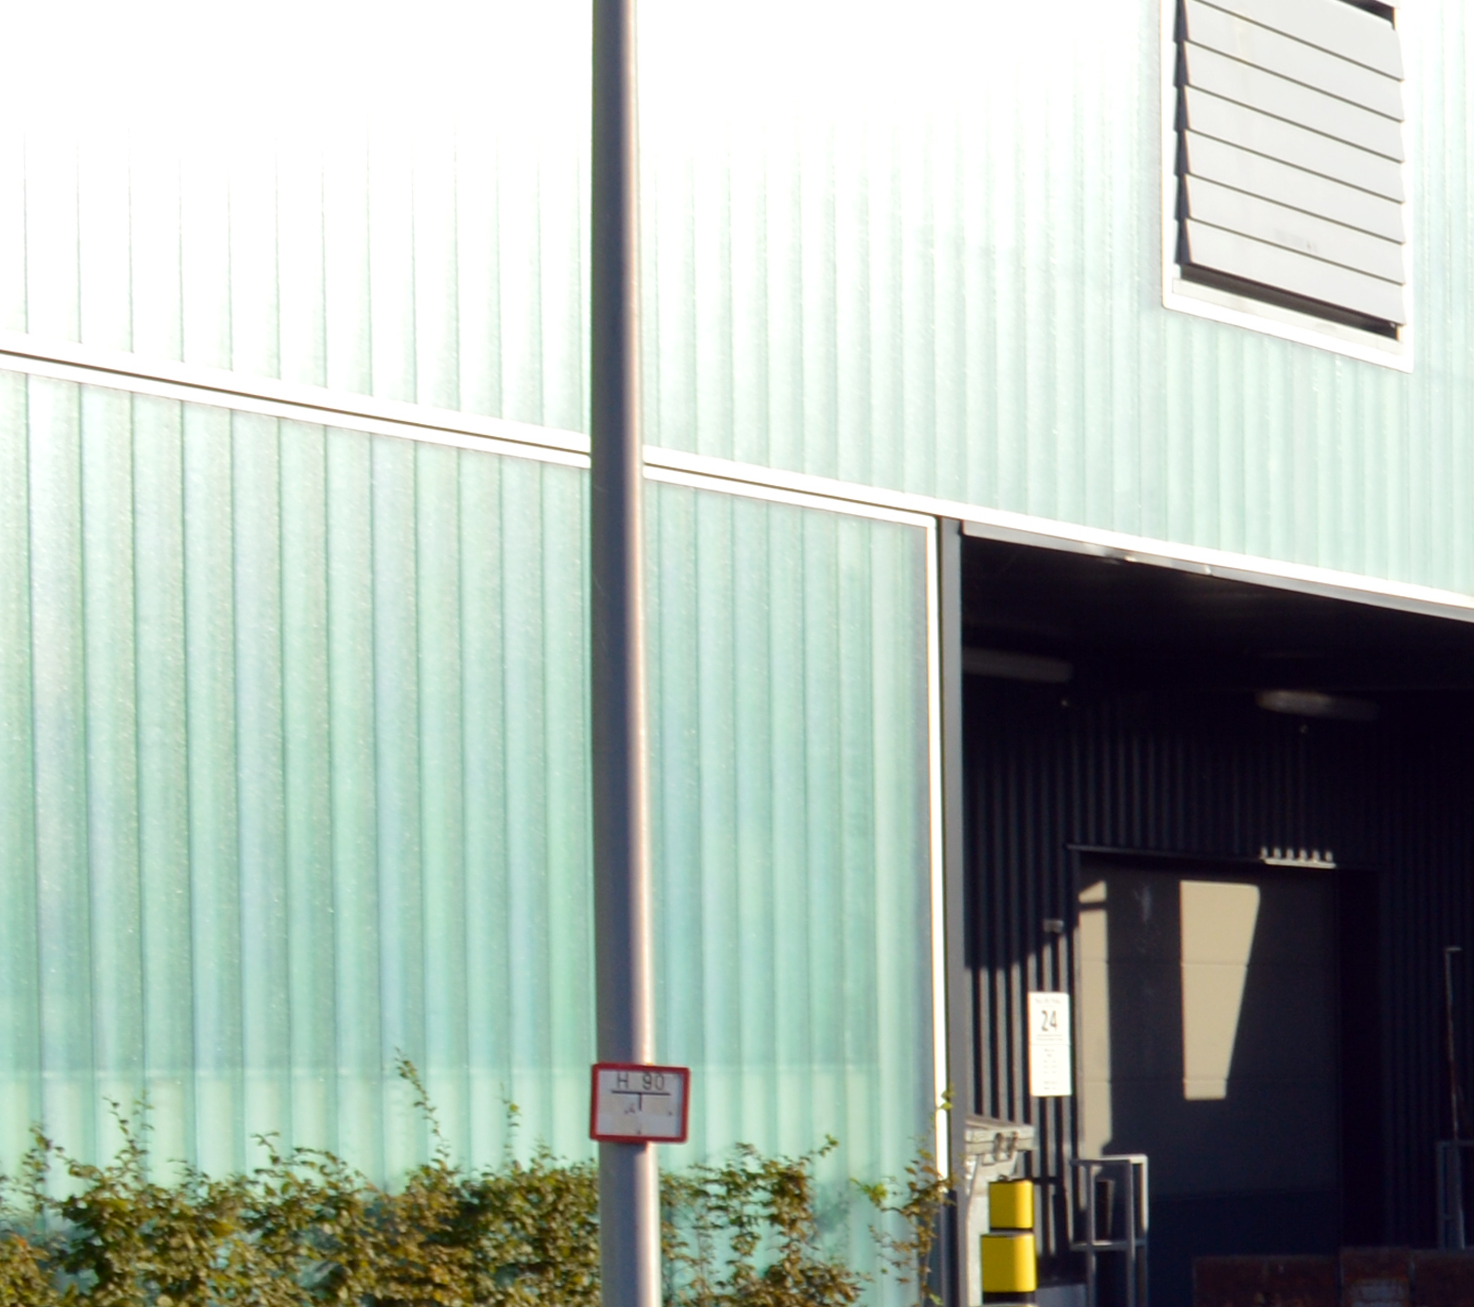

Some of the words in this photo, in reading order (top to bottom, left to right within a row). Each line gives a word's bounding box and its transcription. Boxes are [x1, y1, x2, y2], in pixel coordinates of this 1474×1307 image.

[1041, 1010, 1057, 1031] 24
[617, 1071, 629, 1089] H
[642, 1072, 665, 1090] 90
